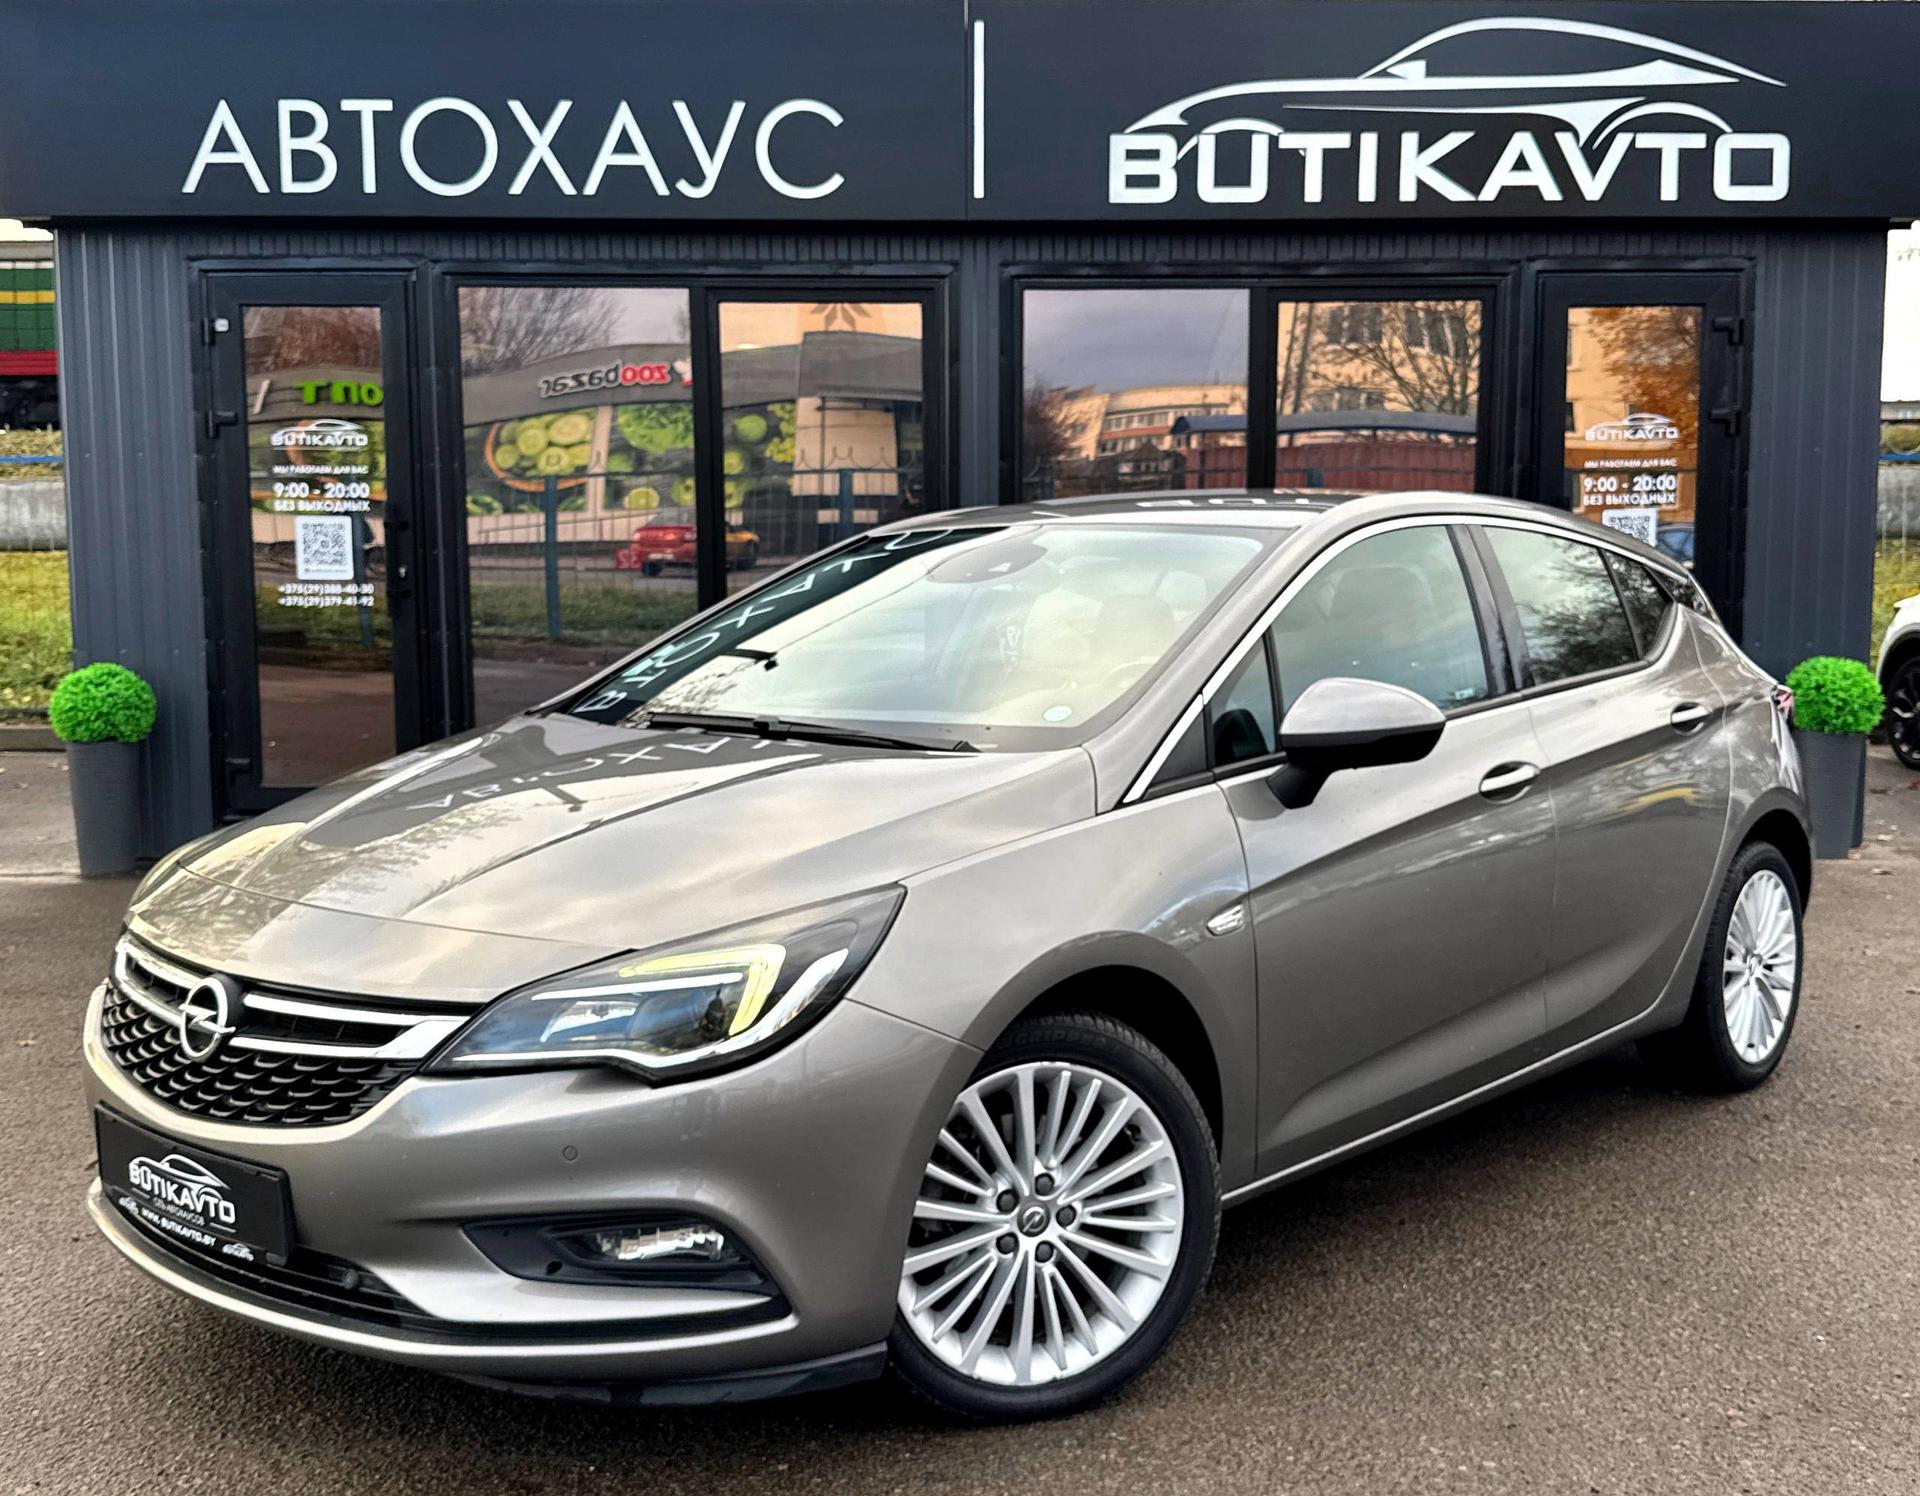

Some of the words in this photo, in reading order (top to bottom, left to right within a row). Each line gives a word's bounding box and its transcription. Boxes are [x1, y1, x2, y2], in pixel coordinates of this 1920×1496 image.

[181, 97, 846, 200] АВТОХАУС
[1108, 131, 1792, 204] BUTIKAVTO
[271, 432, 369, 446] BUTIKAVTO
[1585, 427, 1679, 441] BUTIKAVTO
[273, 482, 310, 498] 9:00
[324, 482, 370, 498] 20:00
[1584, 477, 1618, 492] 9:00
[1632, 475, 1677, 491] 20:00
[297, 499, 371, 512] ВЫХОДНЫХ
[1583, 494, 1603, 506] БЕЗ
[1606, 493, 1676, 505] ВЫХОДНЫХ
[129, 1163, 236, 1224] BUTIKAVTO
